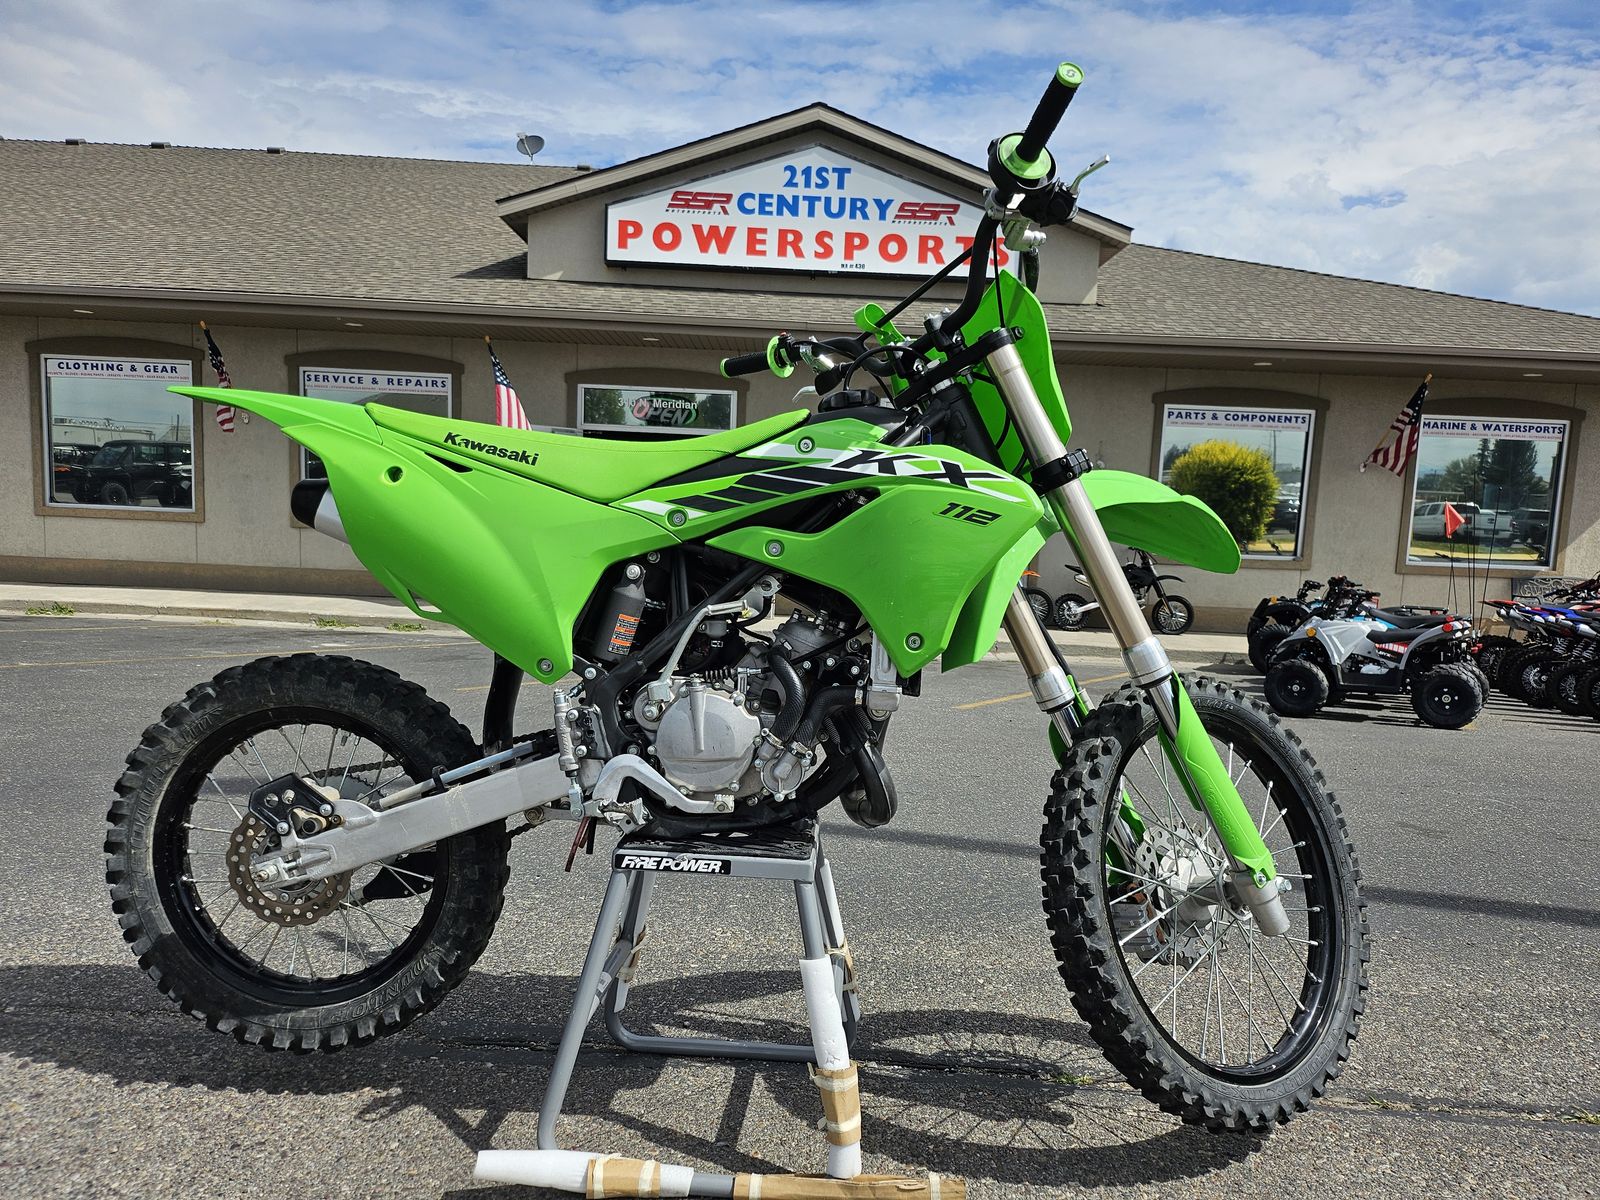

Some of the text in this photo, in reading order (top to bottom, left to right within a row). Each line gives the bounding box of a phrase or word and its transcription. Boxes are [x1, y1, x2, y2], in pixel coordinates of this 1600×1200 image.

[783, 164, 852, 188] 21ST
[667, 190, 734, 215] SSR
[737, 192, 895, 221] CENTURY
[894, 201, 961, 226] SSR
[57, 361, 178, 374] CLOTHING & GEAR
[306, 373, 447, 388] SERVICE & REPAIRS
[632, 400, 690, 426] OPEN
[653, 399, 698, 409] Meridian
[1167, 411, 1307, 424] PARTS & COMPONENTS
[1423, 421, 1564, 434] MARINE & WATERSPORTS
[444, 432, 539, 466] Kawasaki
[829, 450, 1009, 488] KX
[939, 502, 1002, 526] 112
